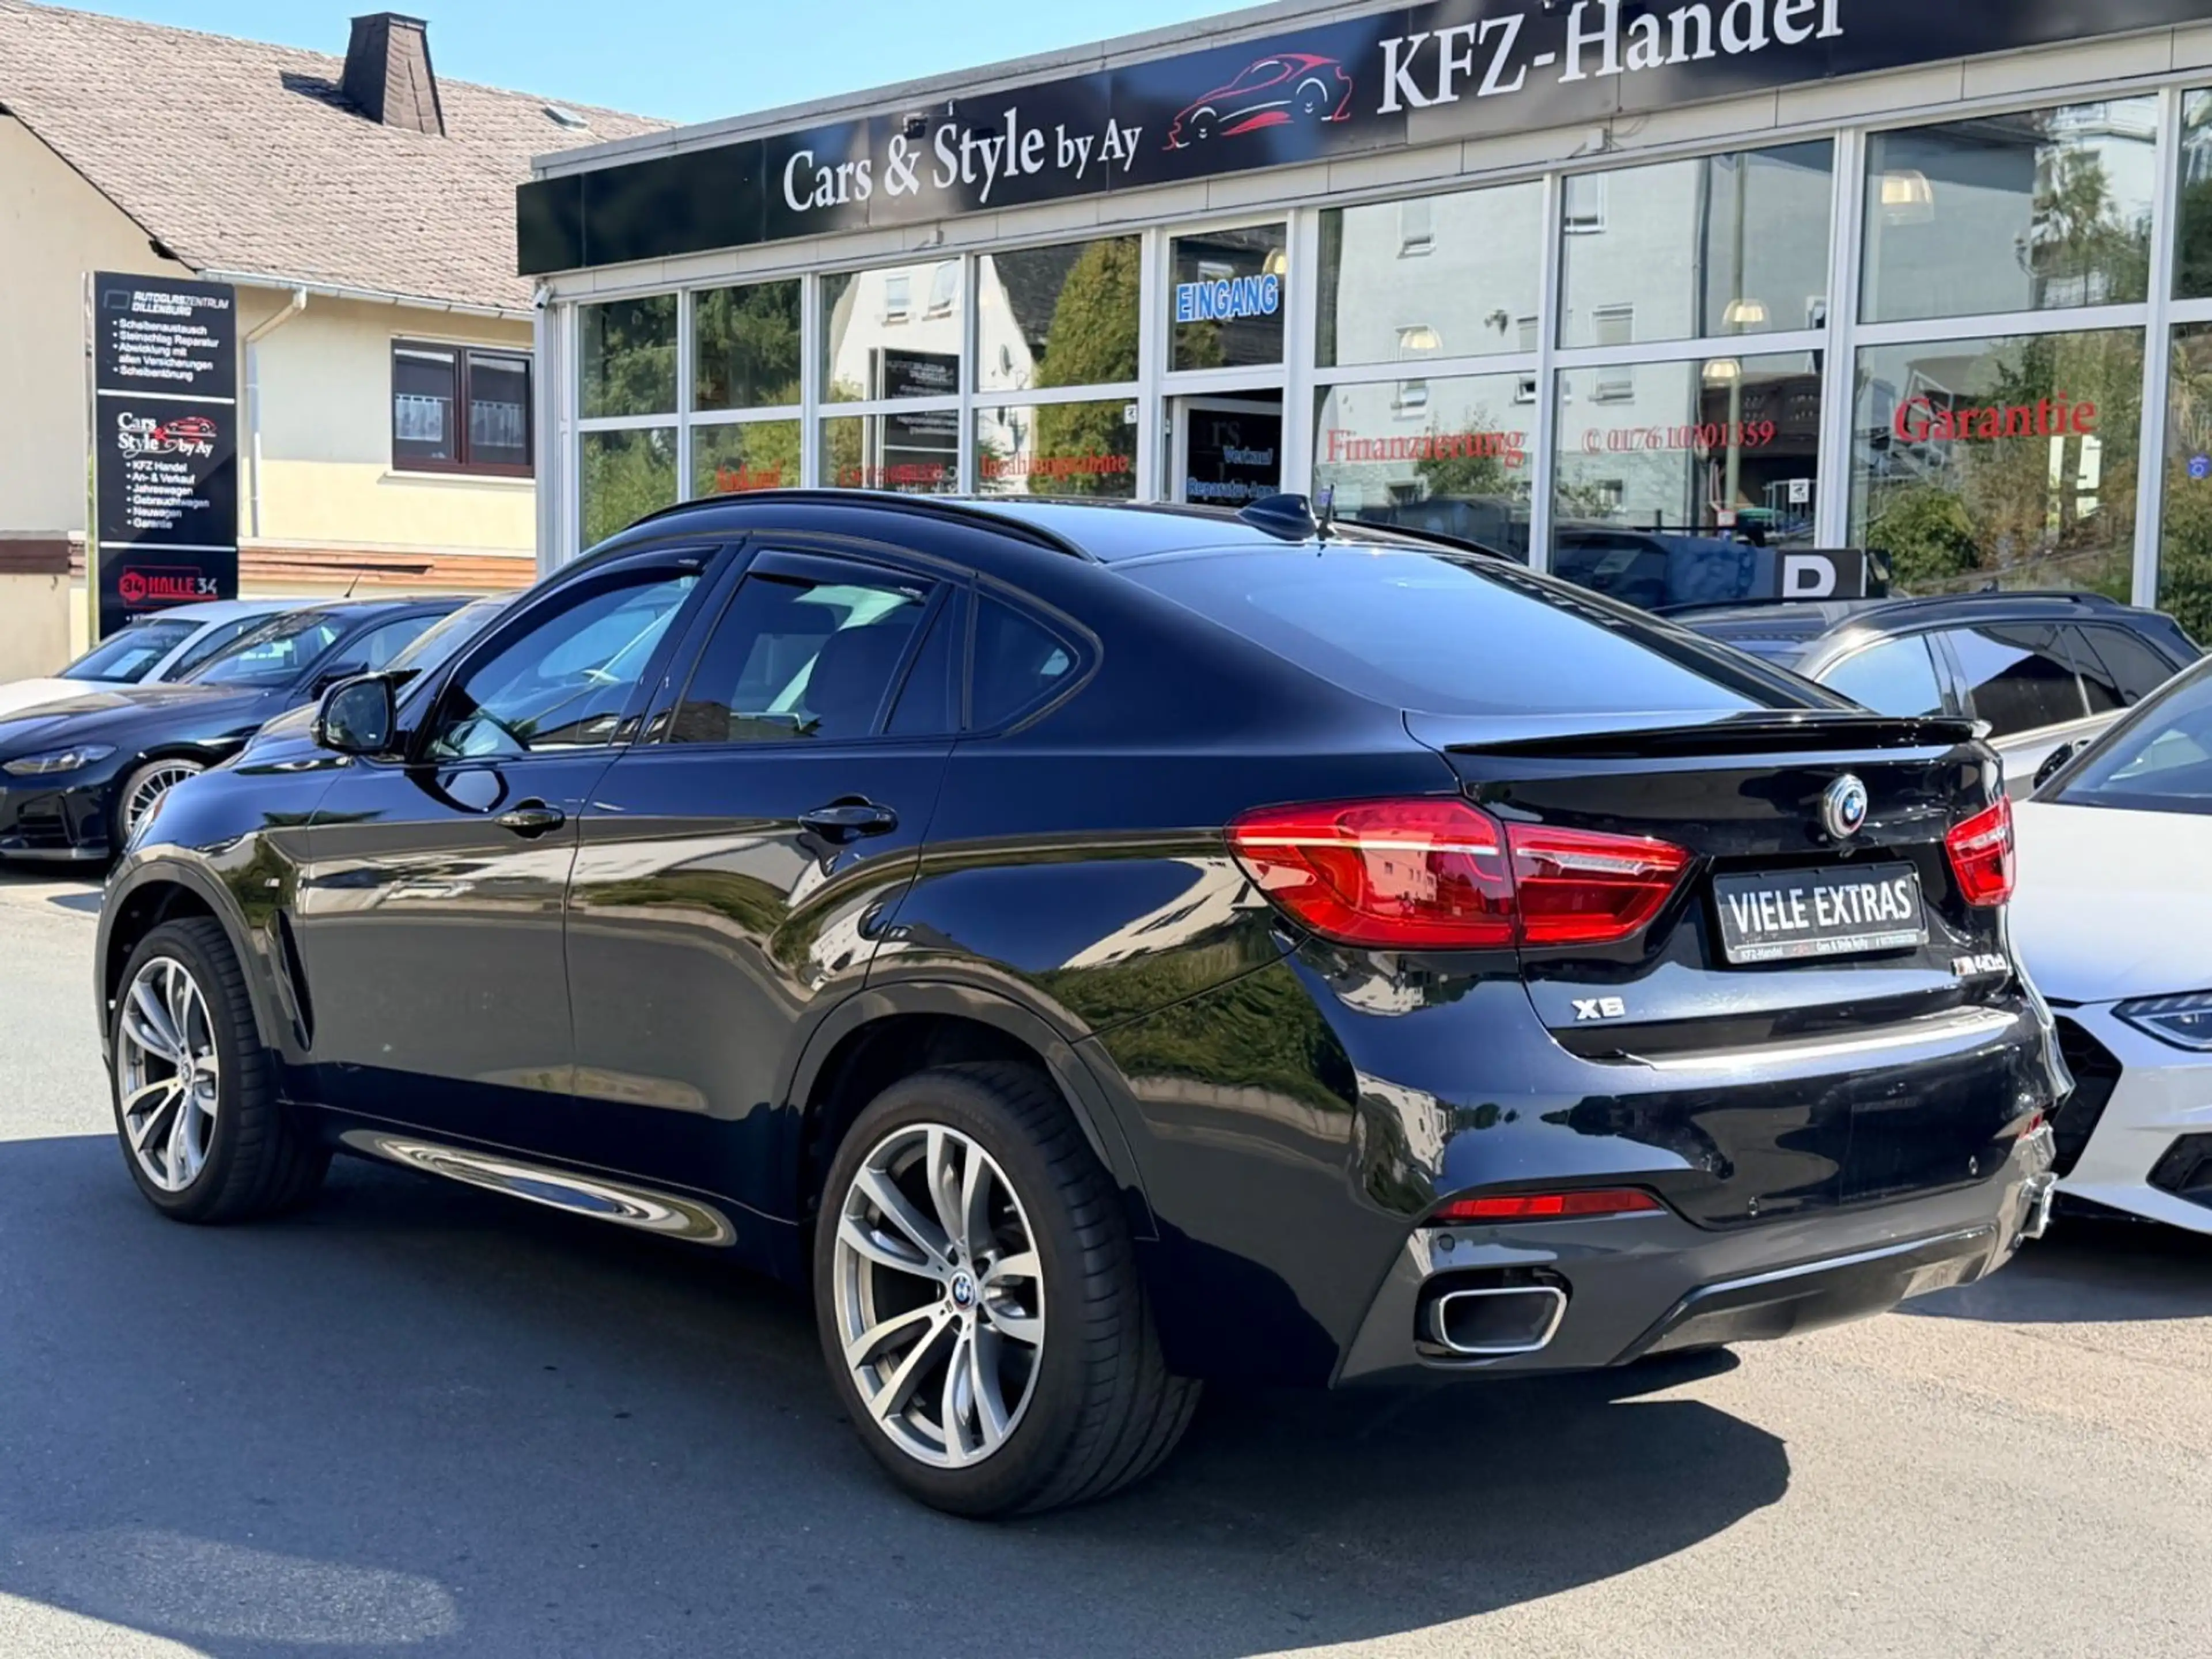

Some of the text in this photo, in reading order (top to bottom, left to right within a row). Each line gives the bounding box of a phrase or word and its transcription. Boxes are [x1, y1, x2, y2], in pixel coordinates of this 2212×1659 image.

[783, 107, 1142, 213] Cars & Style by Ay
[1176, 274, 1279, 323] EINGANG
[118, 412, 157, 430] Cars
[1893, 392, 2099, 442] Garantie
[118, 432, 214, 459] Style by Ay
[1327, 429, 1527, 468] Finanzierung
[132, 460, 187, 472] KFZ Handel
[148, 577, 195, 593] HALLE
[197, 578, 218, 594] 34
[1729, 878, 1912, 934] VIELE EXTRAS
